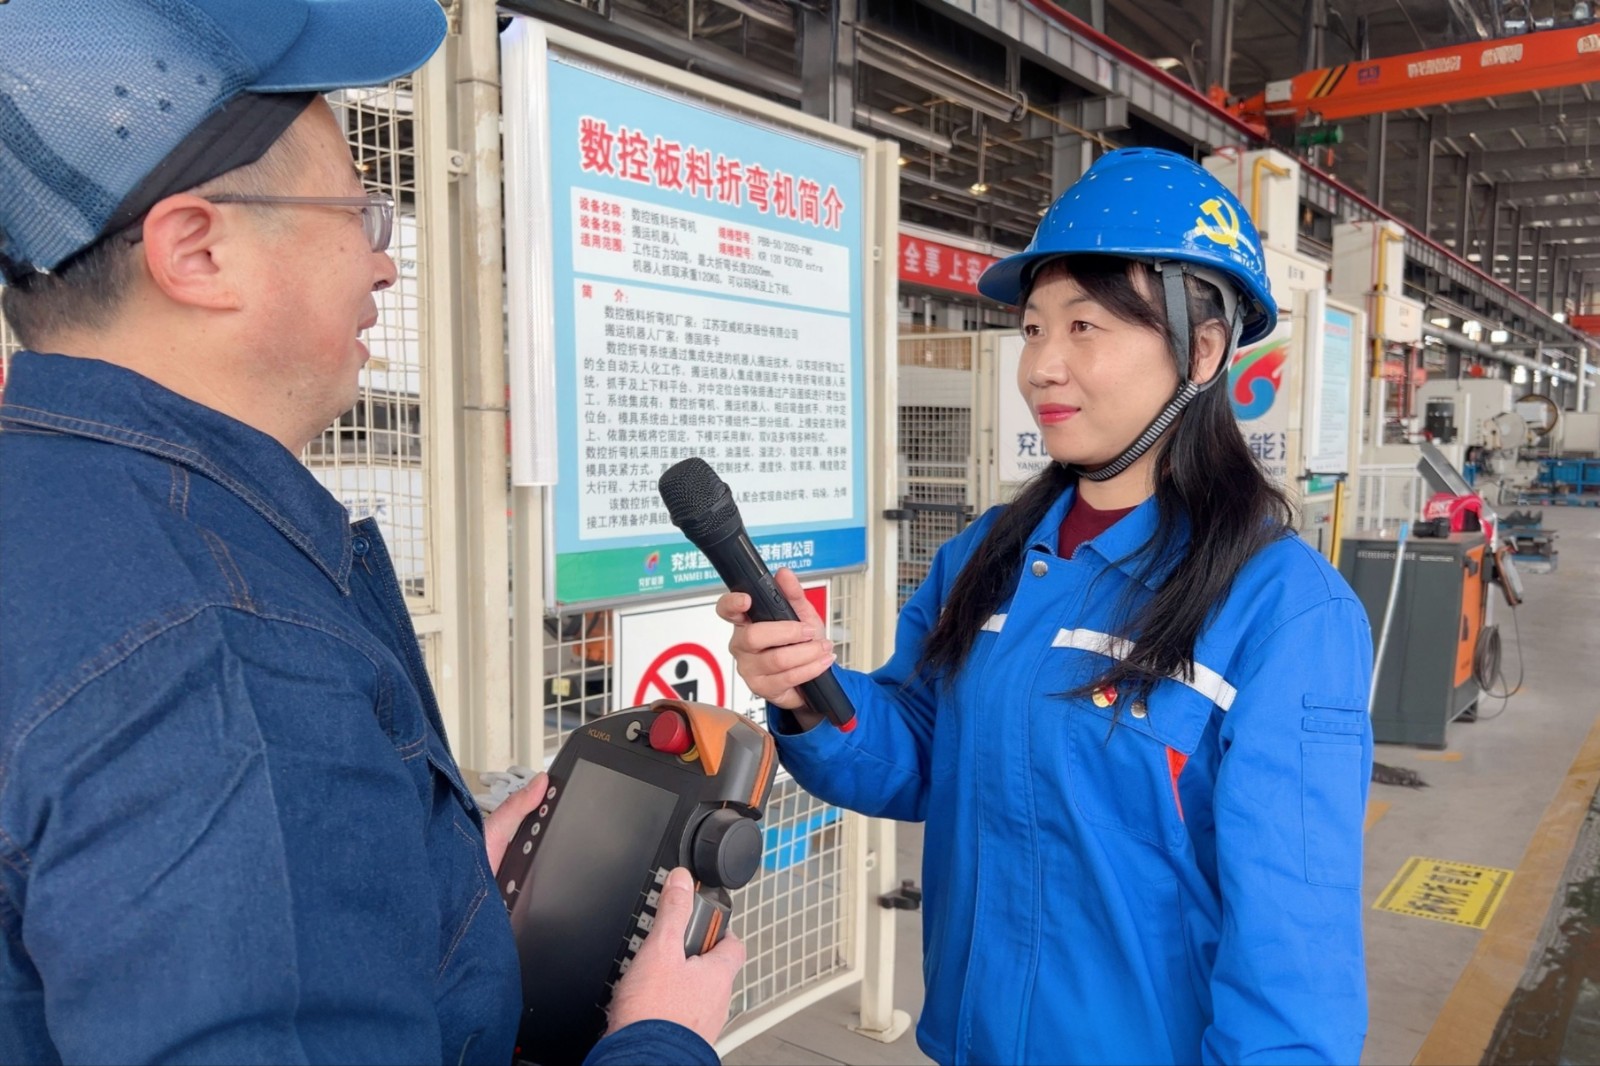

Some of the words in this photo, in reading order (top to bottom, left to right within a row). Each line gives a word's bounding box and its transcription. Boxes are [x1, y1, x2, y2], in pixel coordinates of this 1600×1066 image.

[579, 118, 844, 229] 数控板料折弯机简介
[631, 207, 697, 233] 数控板料折弯机
[631, 225, 680, 246] 搬运机器人
[756, 540, 815, 562] 源有限公司
[588, 728, 610, 743] KUKA
